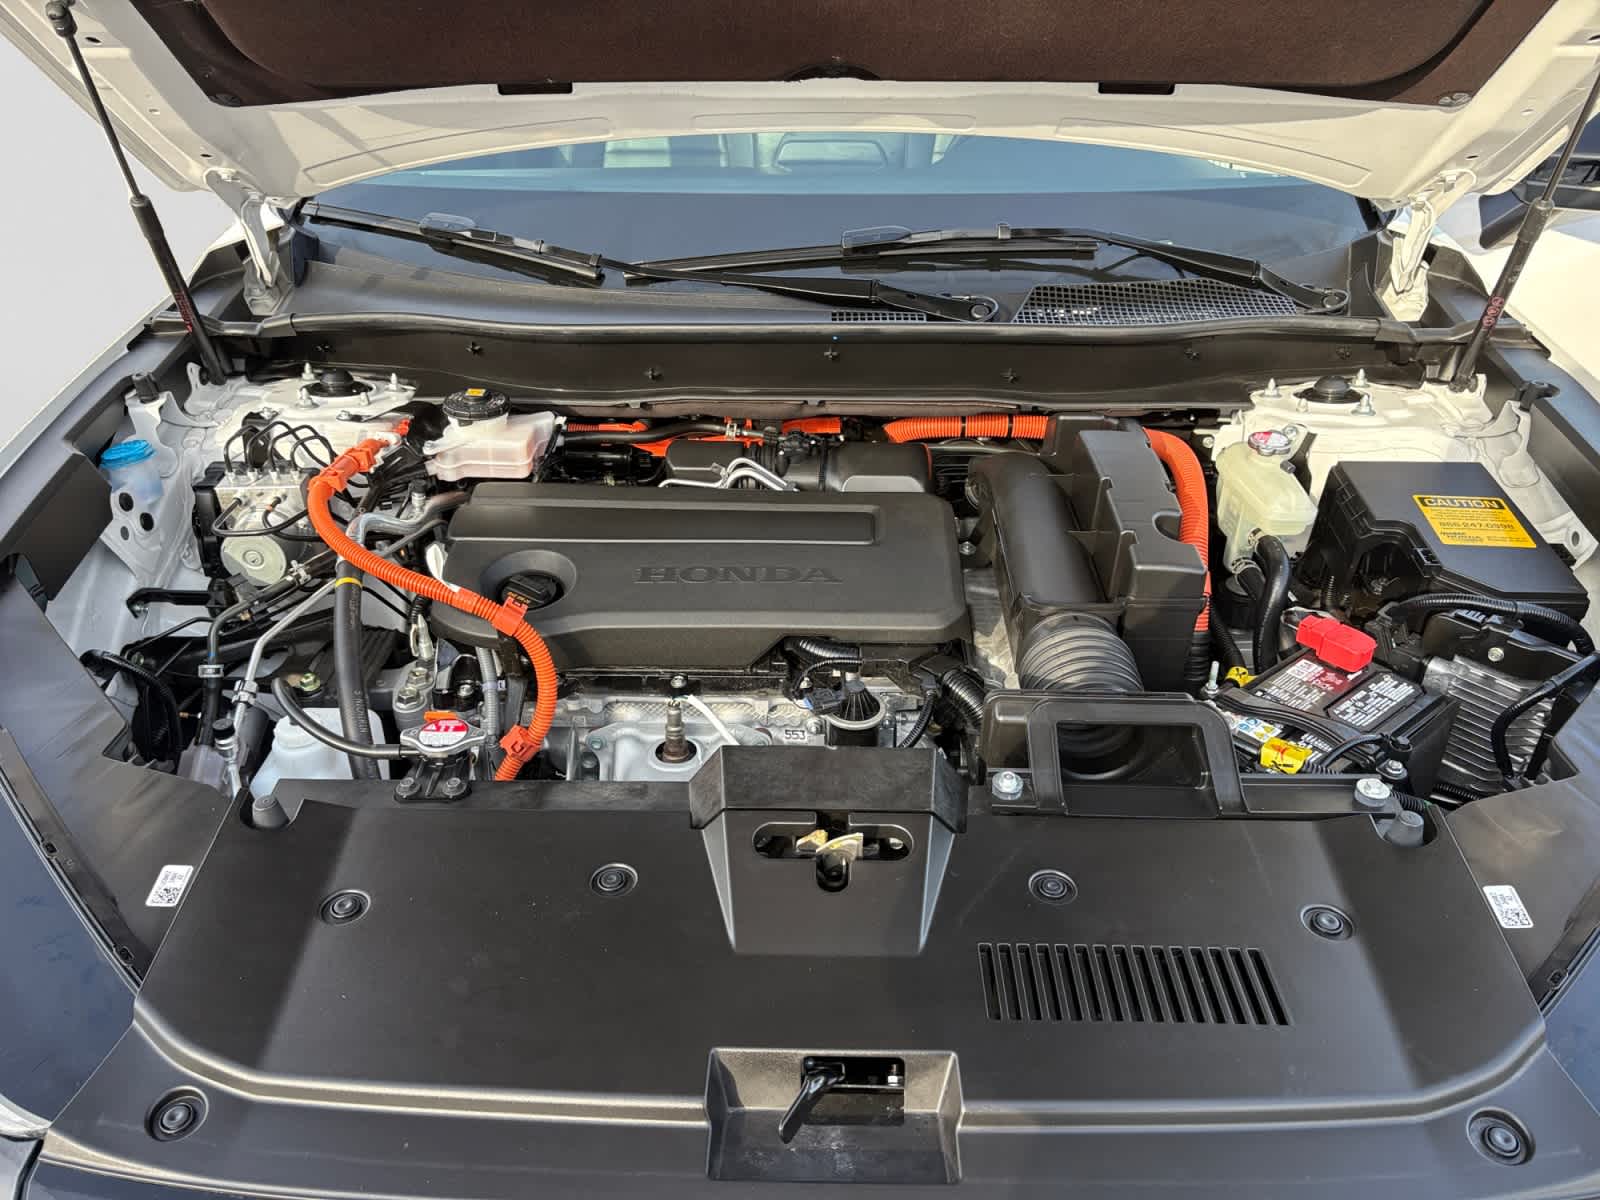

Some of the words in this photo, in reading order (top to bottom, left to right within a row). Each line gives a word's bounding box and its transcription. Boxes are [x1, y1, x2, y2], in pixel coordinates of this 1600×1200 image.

[1424, 498, 1498, 508] CAUTION
[633, 566, 844, 585] HONDA
[784, 729, 806, 740] 553
